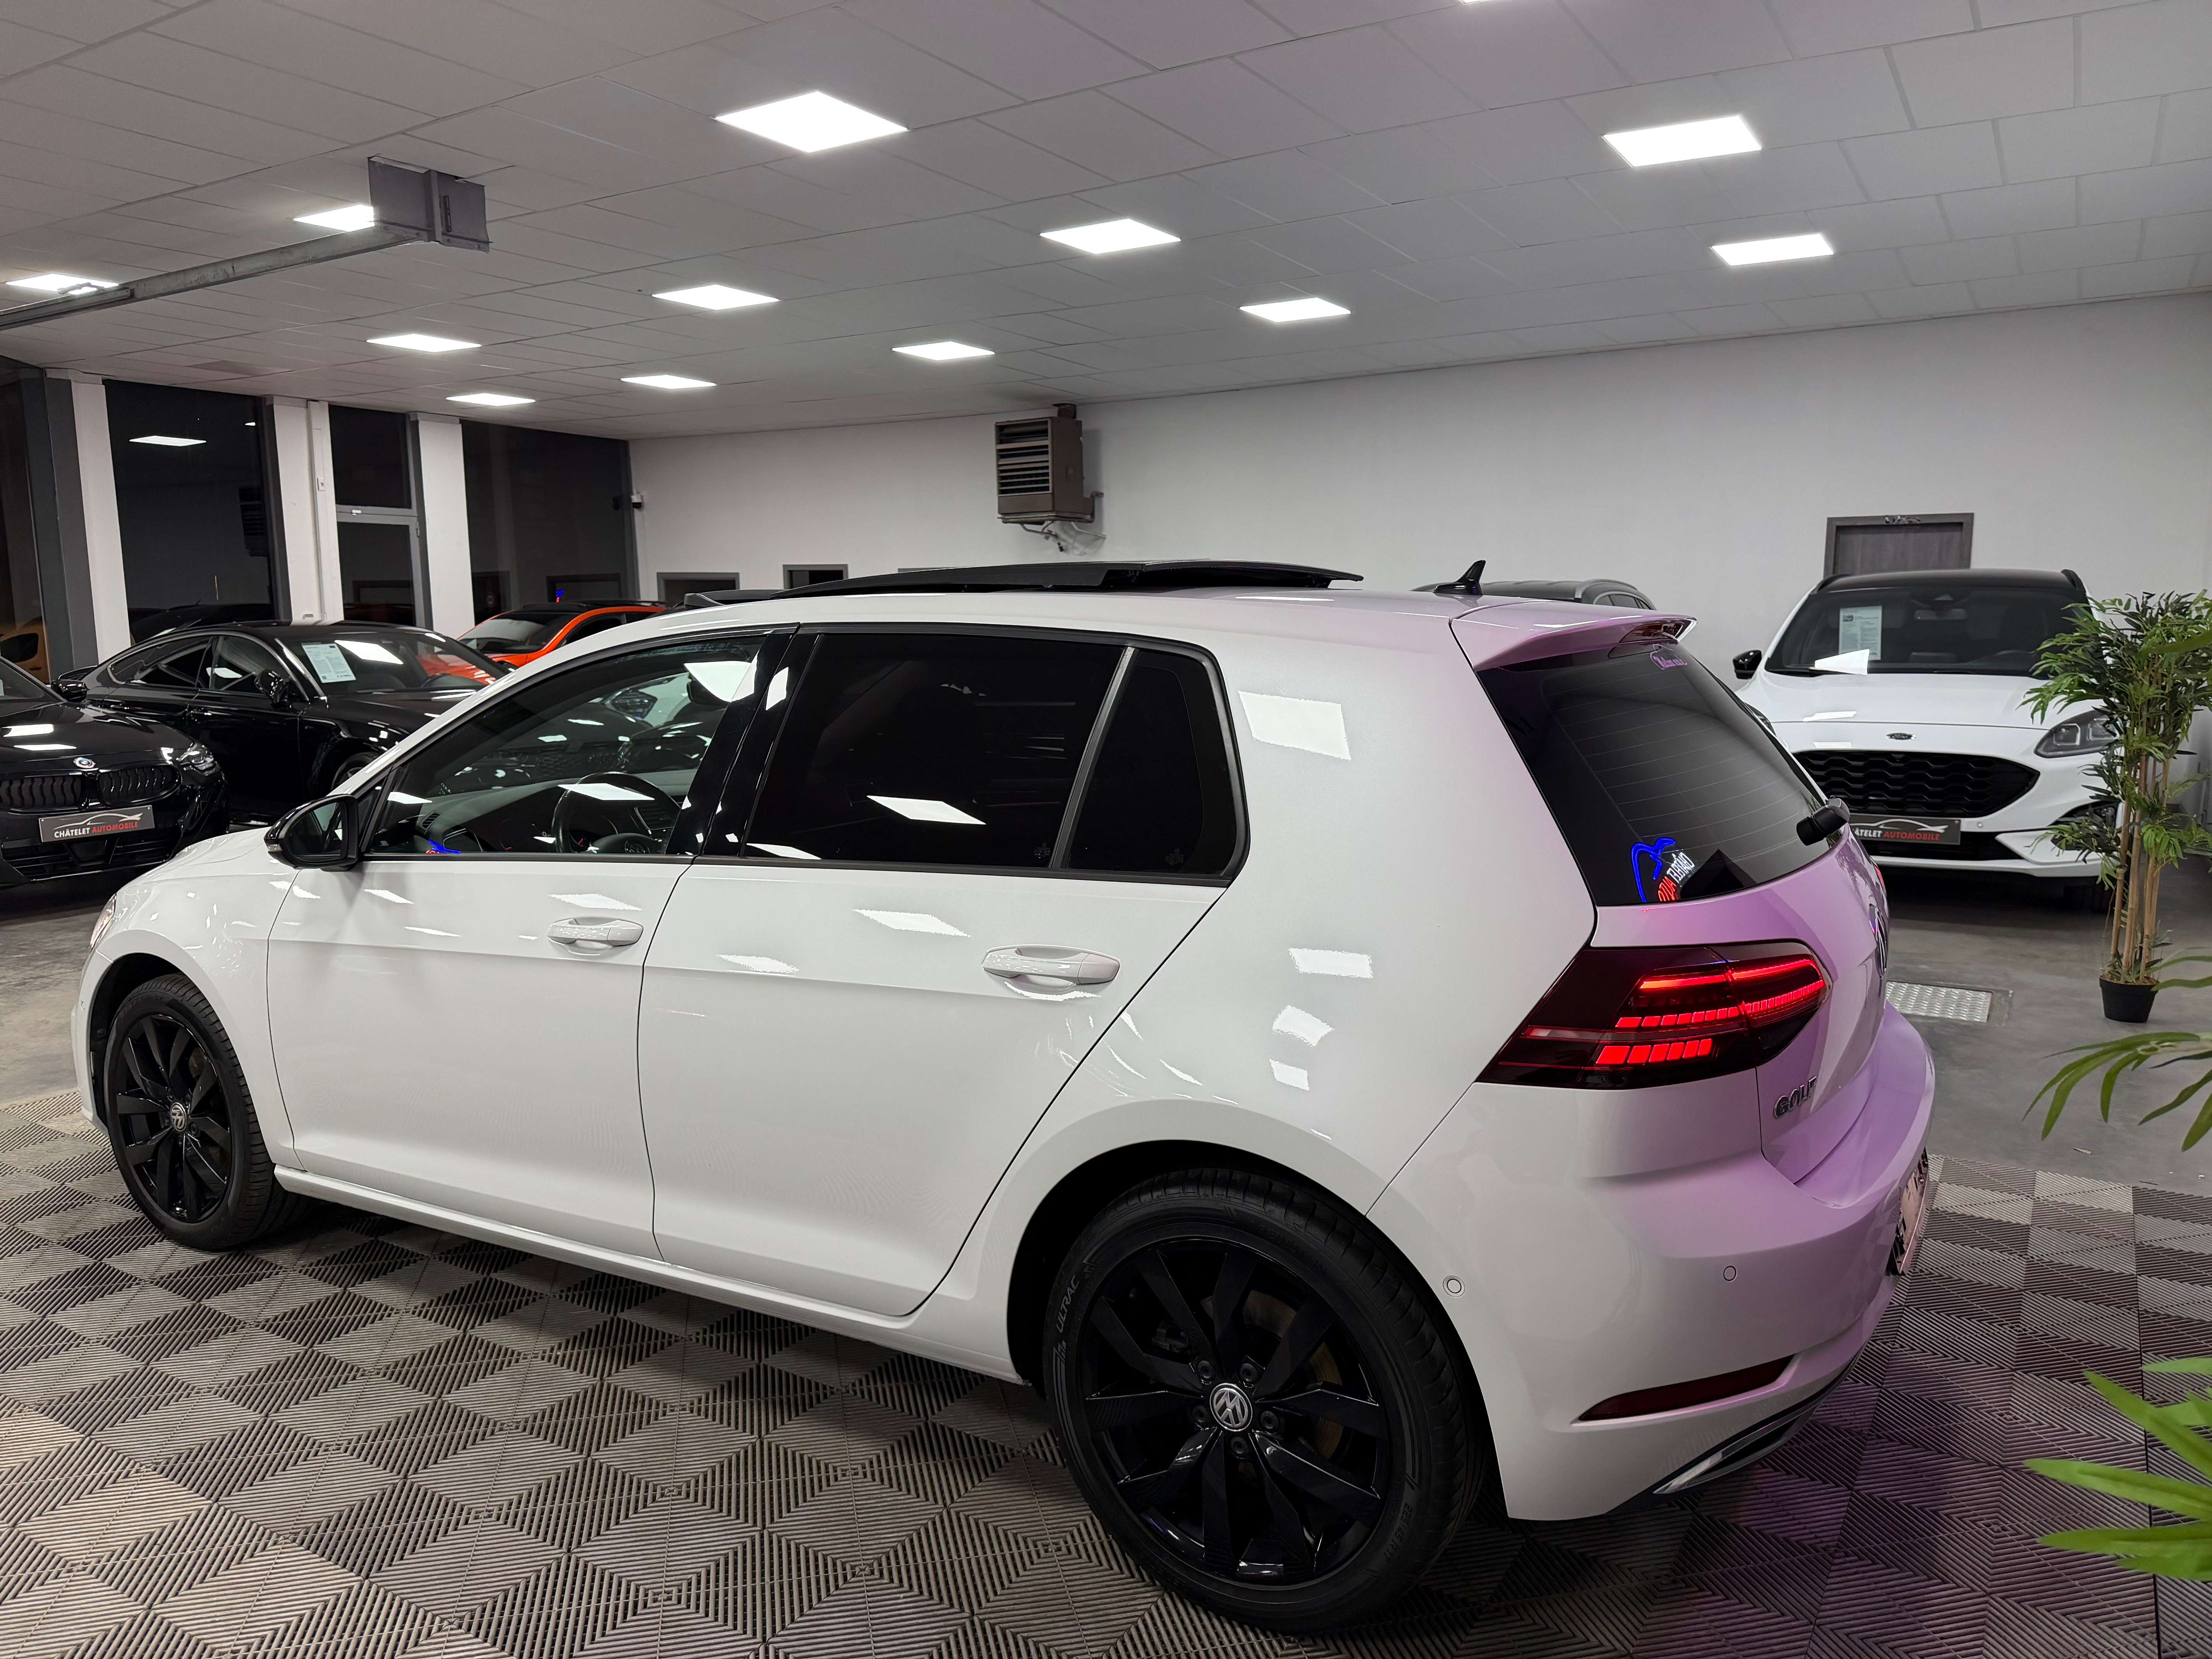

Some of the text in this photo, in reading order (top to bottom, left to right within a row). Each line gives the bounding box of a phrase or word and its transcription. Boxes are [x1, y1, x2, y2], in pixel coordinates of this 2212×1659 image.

[54, 822, 139, 838] CHÂTELET AUTOMOBILE
[1852, 828, 1940, 841] ÂTELET AUTOMOBILE
[1774, 1076, 1817, 1118] GOLF
[1056, 1274, 1080, 1333] ULTRAC
